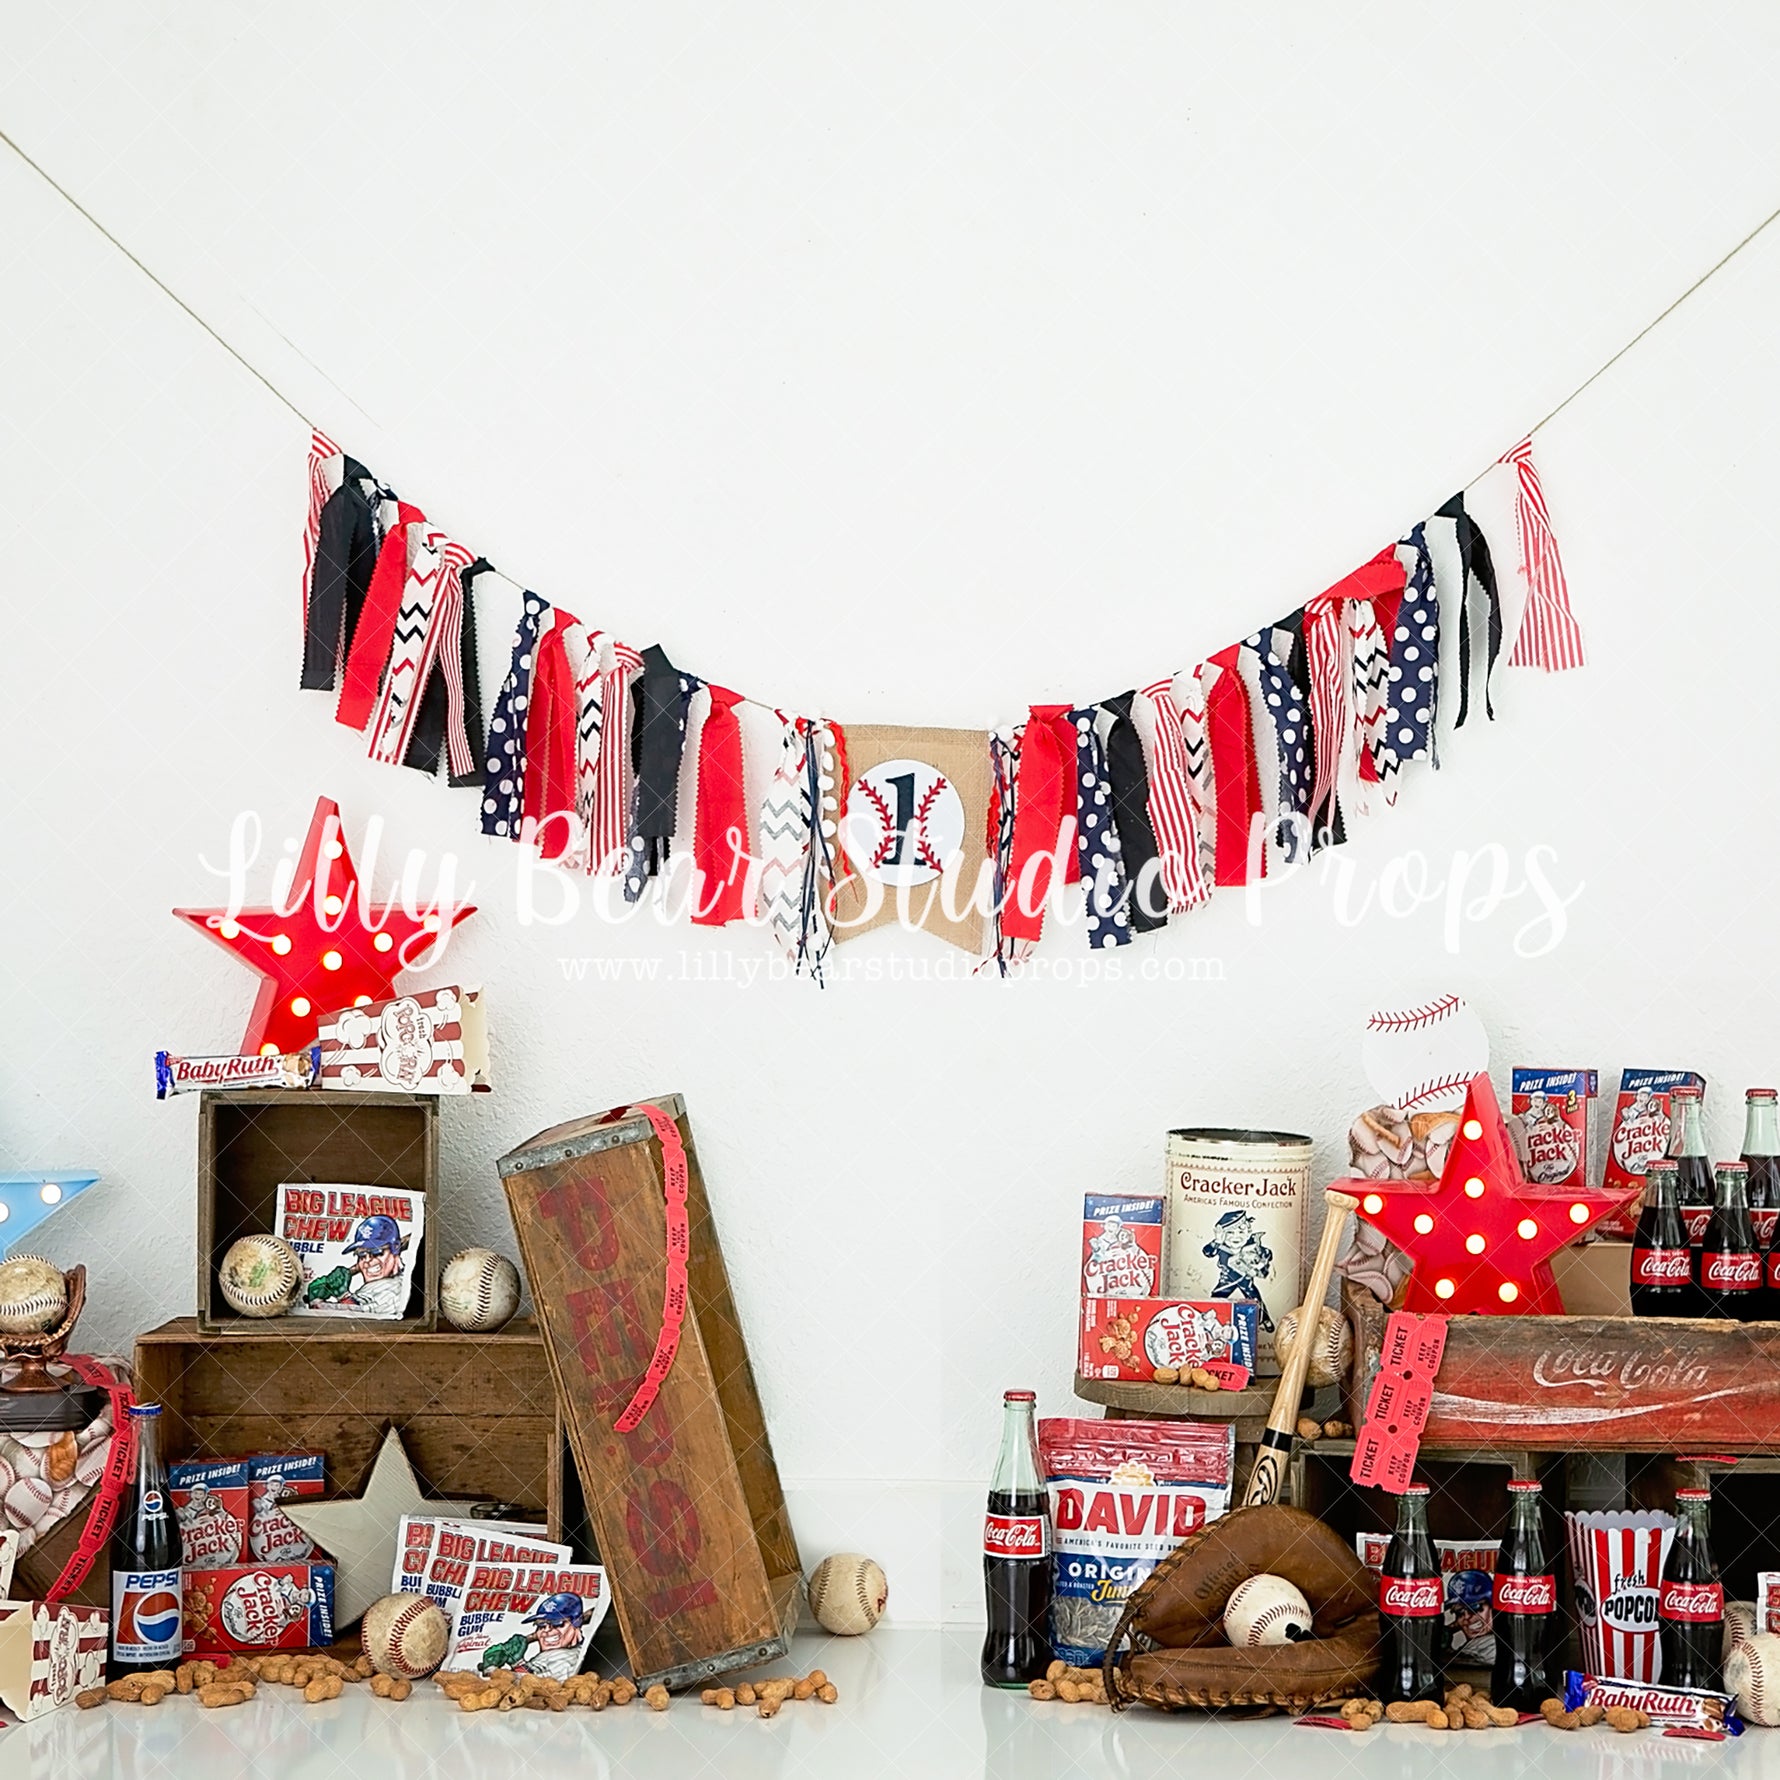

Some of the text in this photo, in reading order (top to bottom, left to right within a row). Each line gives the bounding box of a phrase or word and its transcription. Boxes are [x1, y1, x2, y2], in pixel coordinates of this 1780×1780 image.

[882, 773, 927, 865] 1
[1519, 1078, 1543, 1092] PRIZE
[1545, 1073, 1576, 1088] INSIDE!
[1628, 1076, 1651, 1089] PRIZE
[1567, 1089, 1577, 1106] 3
[1528, 1127, 1582, 1148] racker
[1614, 1121, 1671, 1143] Cracke
[1527, 1144, 1567, 1168] Jack
[1621, 1138, 1663, 1160] Jack
[1180, 1171, 1297, 1197] Cracker Jack
[284, 1189, 413, 1221] BIG LEAGUE
[1093, 1199, 1155, 1217] PRIZE INSIDE!
[283, 1216, 354, 1242] CHEW
[1086, 1254, 1159, 1277] Cracker
[1097, 1269, 1143, 1294] Jack
[1178, 1305, 1202, 1368] Cracke
[1237, 1313, 1250, 1341] PRIZE
[1160, 1318, 1186, 1365] Jack
[1390, 1326, 1408, 1367] TICKET
[1418, 1342, 1427, 1362] KEEP
[1427, 1339, 1440, 1369] COUPON
[1374, 1383, 1395, 1420] TICKET
[1403, 1399, 1414, 1418] KEEP
[1413, 1397, 1427, 1426] COUPON
[111, 1440, 129, 1480] TICKET
[255, 1456, 317, 1477] PRIZE INSIDE!
[1360, 1438, 1379, 1478] TICKET
[1387, 1455, 1398, 1476] KEEP
[1398, 1452, 1411, 1484] COUPON
[179, 1463, 241, 1486] PRIZE INSIDE!
[91, 1499, 113, 1540] TICKET
[1056, 1488, 1206, 1537] DAVID
[248, 1516, 291, 1537] Crac
[405, 1522, 435, 1548] BI
[185, 1537, 231, 1563] Jack
[260, 1528, 306, 1553] Jack
[437, 1530, 475, 1563] BIG
[61, 1557, 88, 1592] TICKET
[126, 1571, 179, 1589] PEPSI
[470, 1566, 601, 1598] BIG LEAGUE
[1068, 1562, 1152, 1580] ORIGIN
[1613, 1570, 1645, 1595] fresh
[426, 1584, 462, 1599] BUBBL
[463, 1592, 539, 1614] CHEW
[1091, 1579, 1133, 1602] Jum
[237, 1586, 264, 1634] Jack
[253, 1573, 280, 1647] Cracker
[313, 1575, 333, 1638] PRIZE INSIDE!
[1604, 1595, 1660, 1623] POPCO
[457, 1625, 484, 1638] GUM
[459, 1613, 506, 1626] BUBBLE
